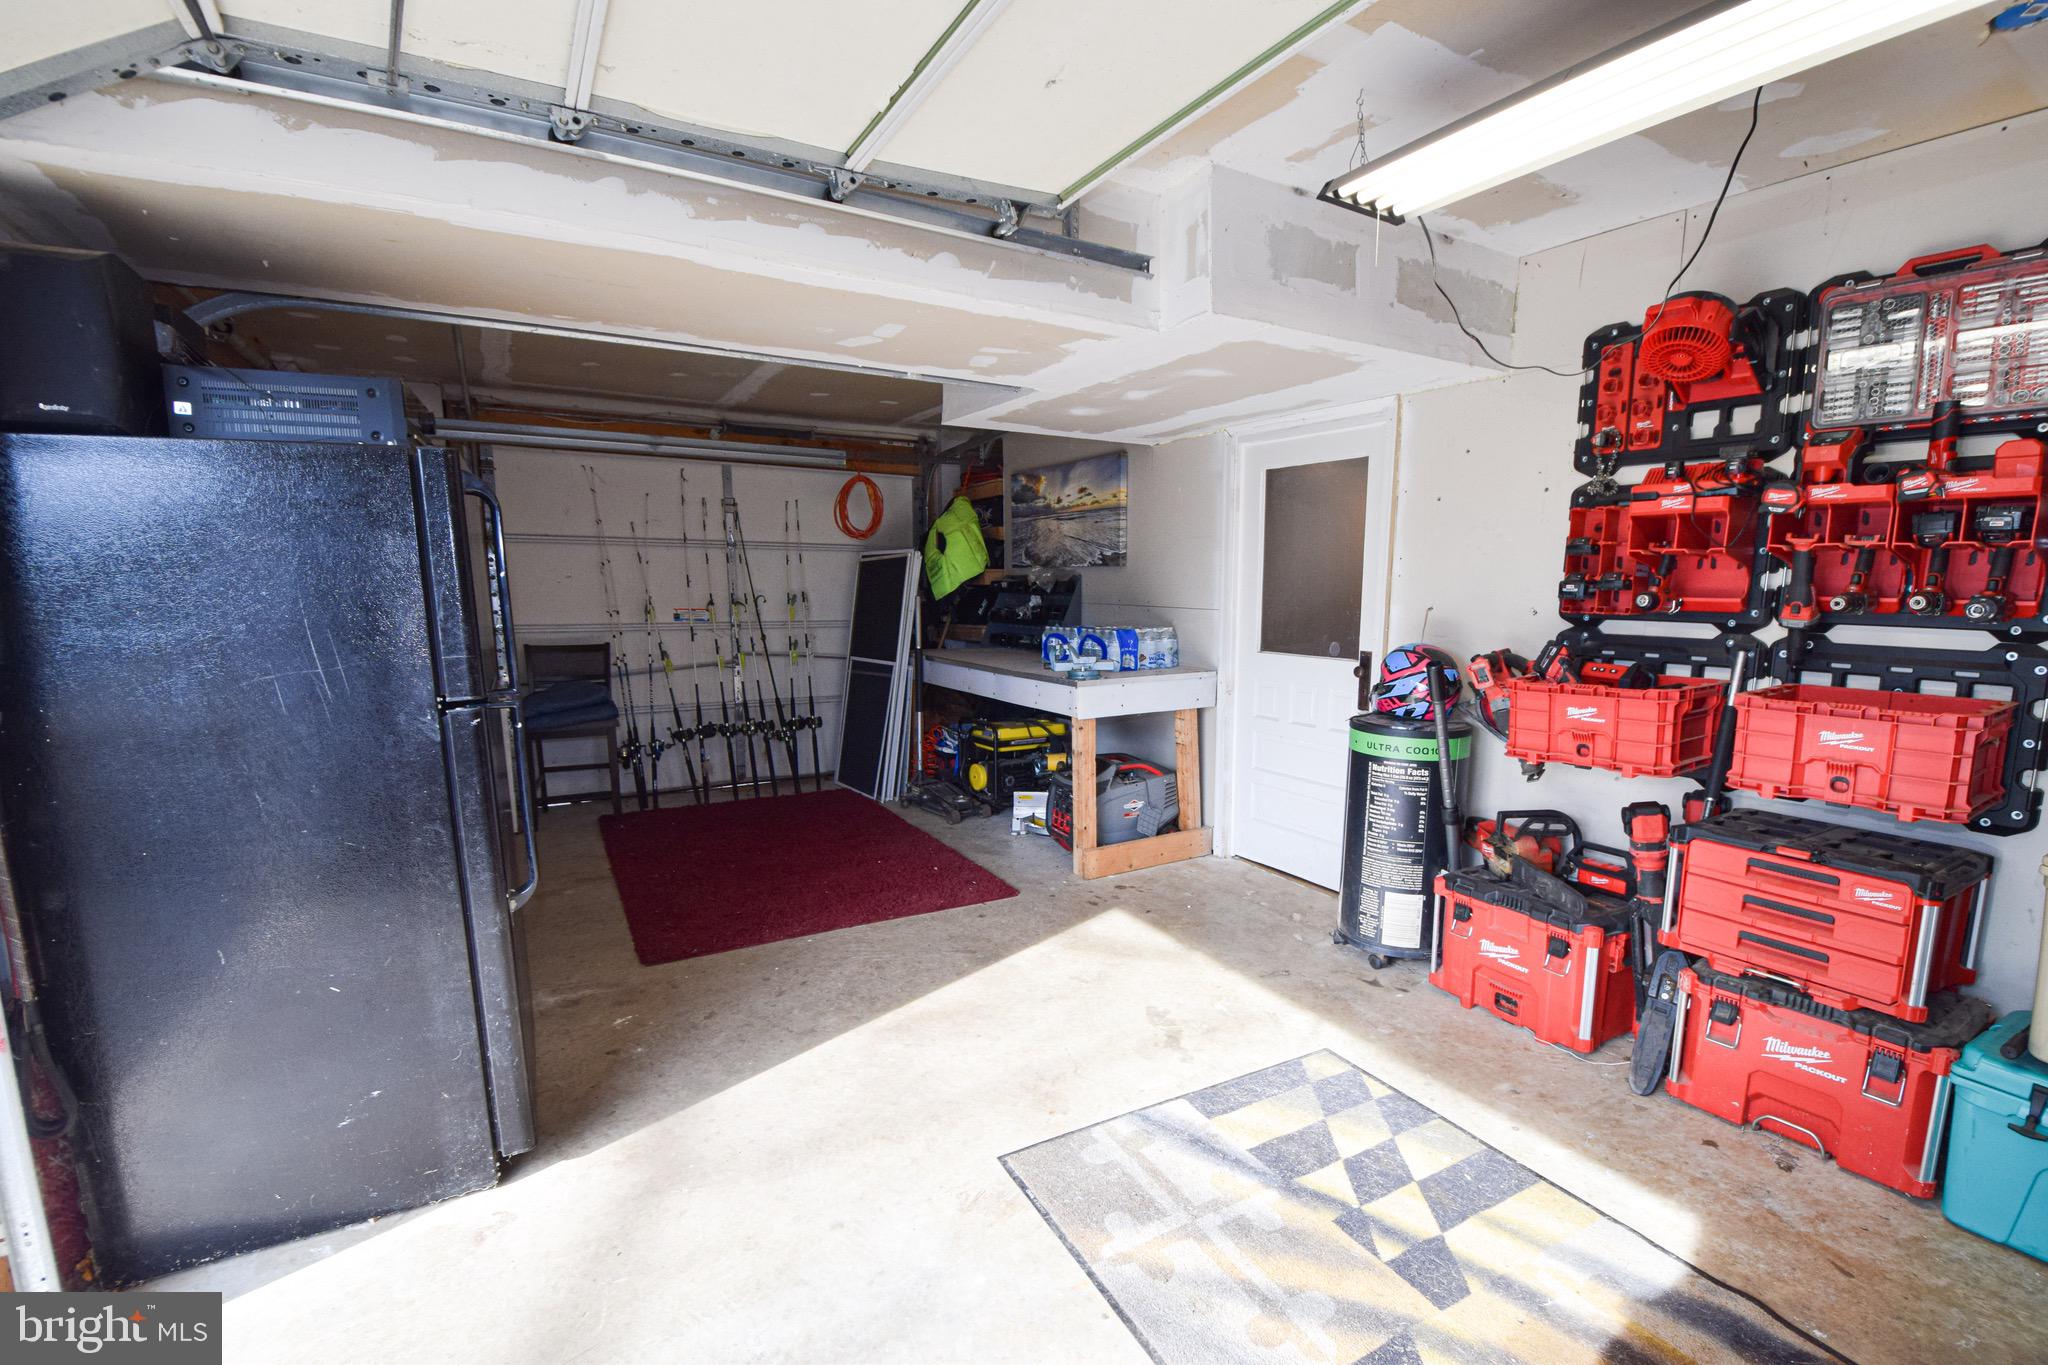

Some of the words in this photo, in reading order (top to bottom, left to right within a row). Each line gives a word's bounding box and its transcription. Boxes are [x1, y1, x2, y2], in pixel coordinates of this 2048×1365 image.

[1366, 741, 1400, 753] ULTRA
[1372, 763, 1405, 776] Nutrition
[1407, 767, 1429, 777] Facts
[1762, 1036, 1831, 1059] Milwaukee
[1794, 1062, 1848, 1084] PACKOUT
